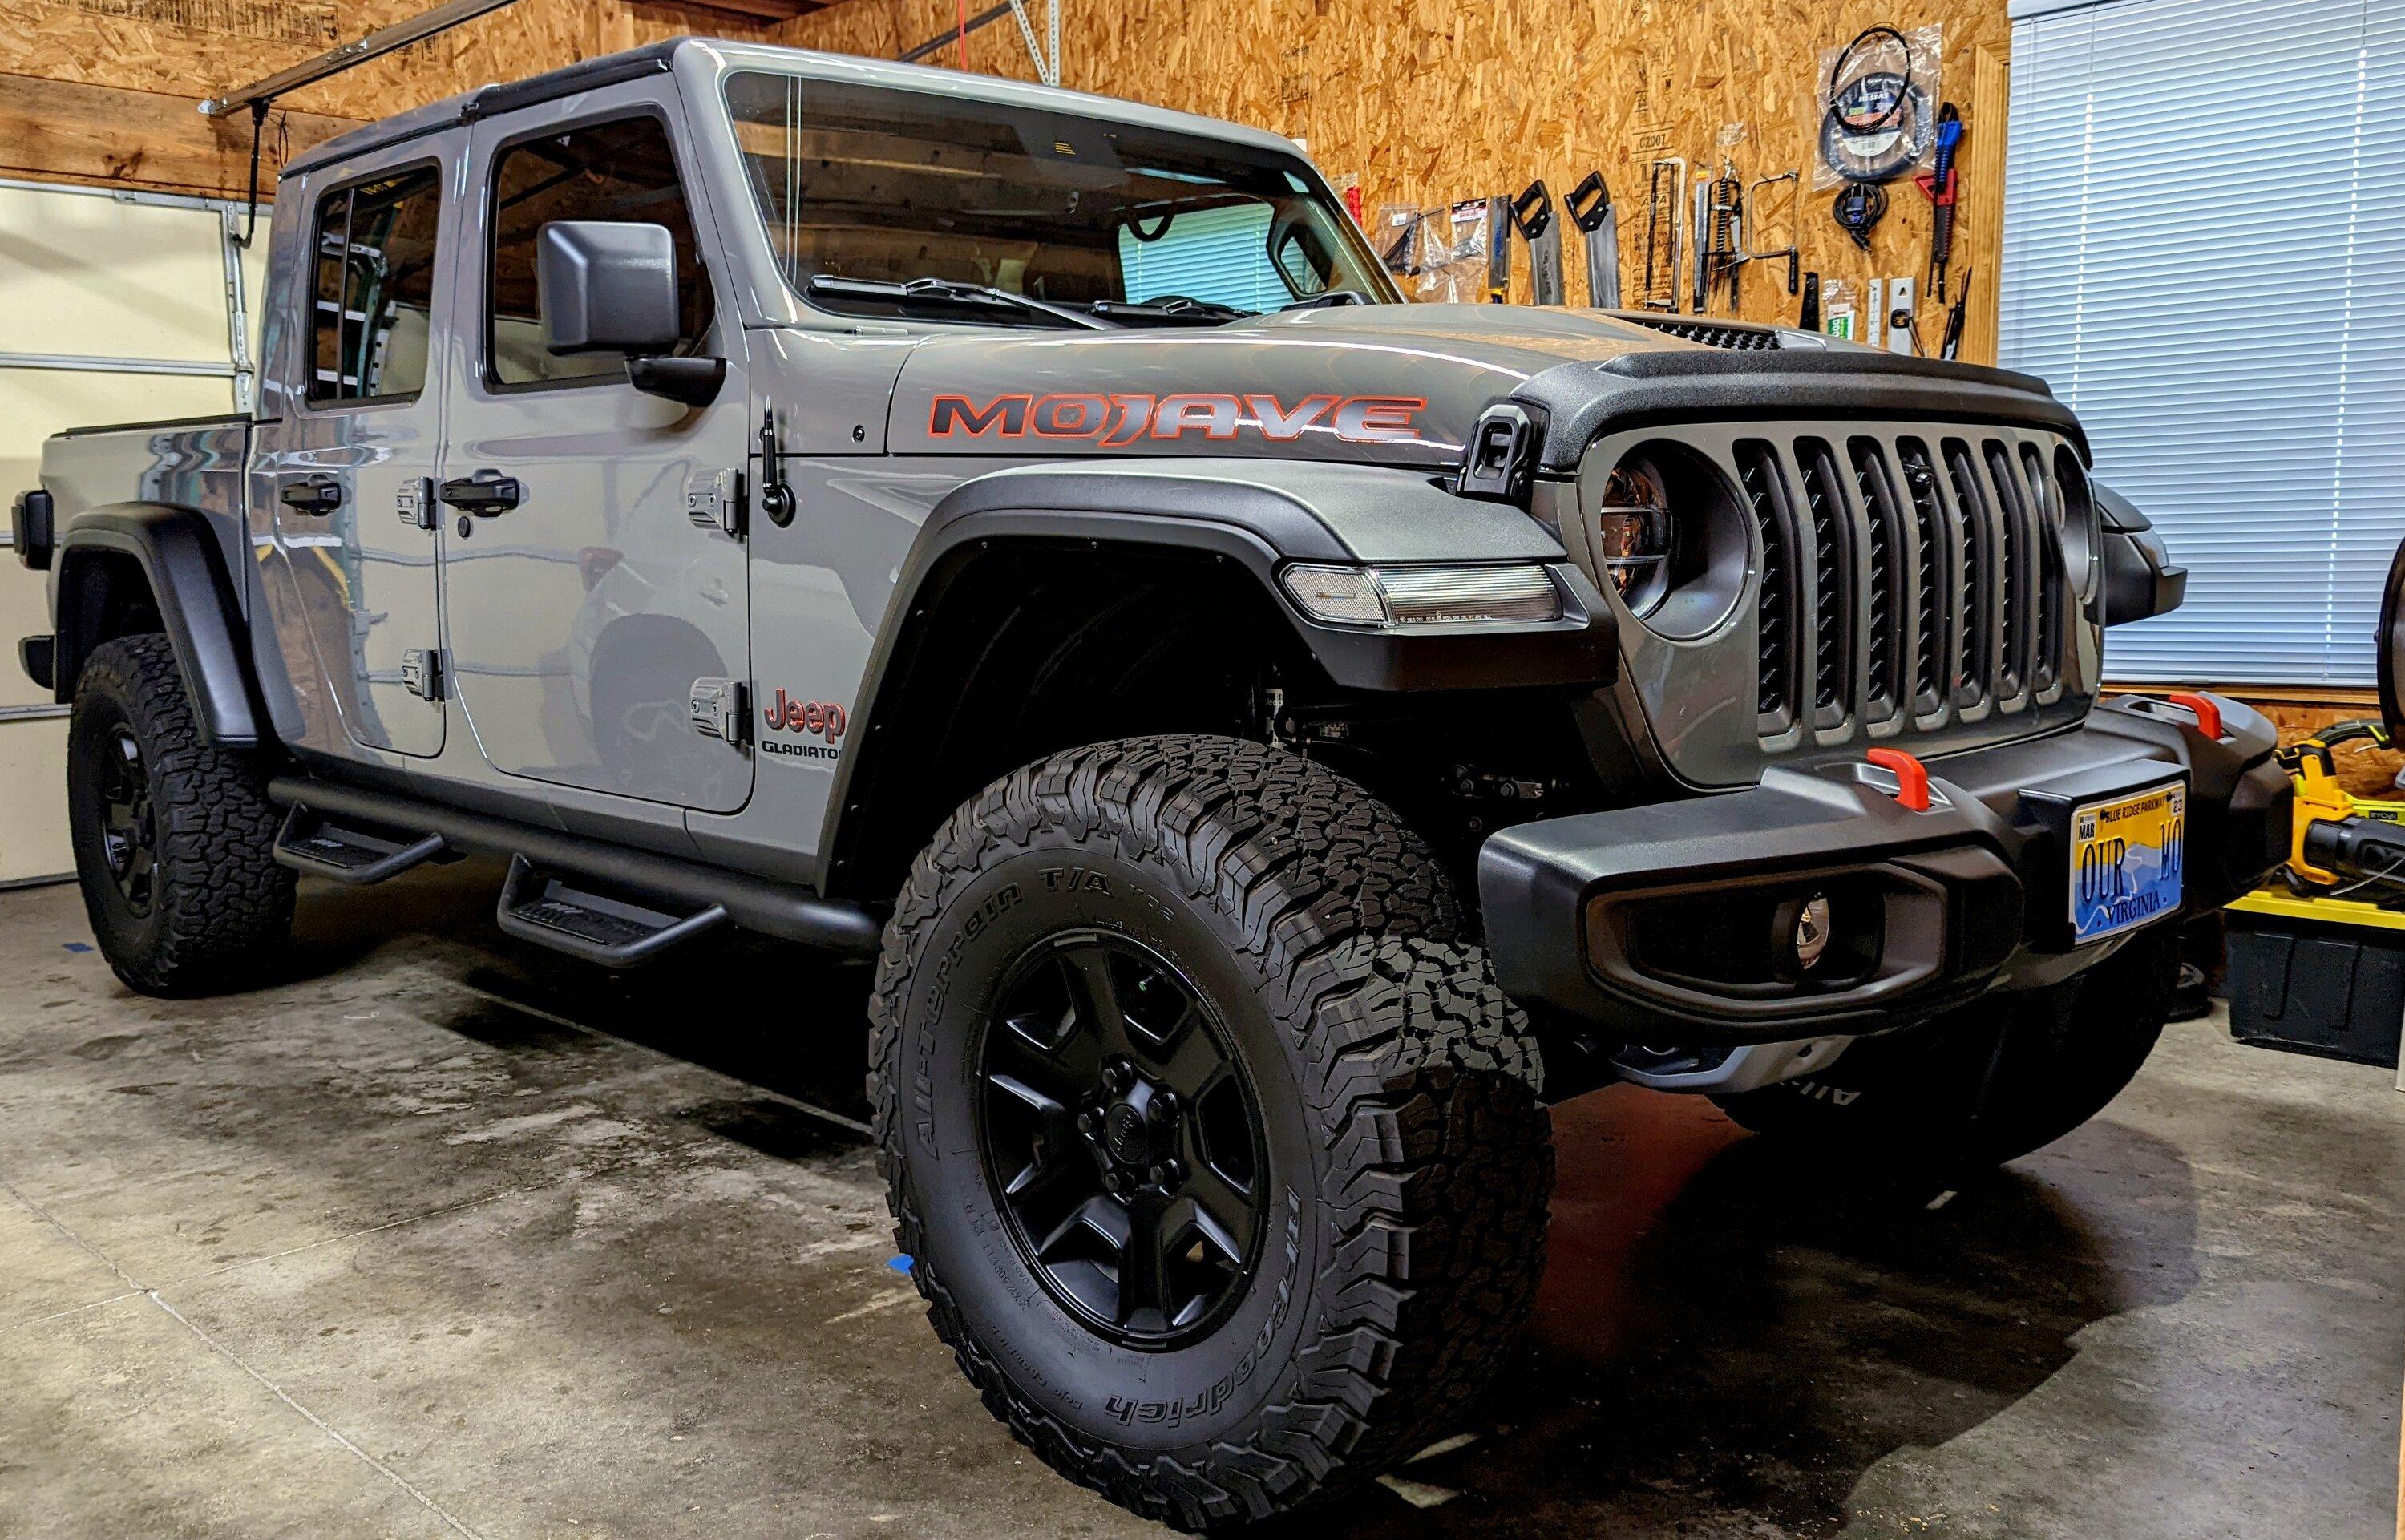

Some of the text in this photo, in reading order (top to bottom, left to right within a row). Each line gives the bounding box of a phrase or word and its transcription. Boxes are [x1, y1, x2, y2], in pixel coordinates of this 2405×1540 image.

[926, 393, 1429, 447] MOJAVE
[764, 688, 846, 745] Jeep
[2079, 823, 2095, 840] MAR
[2122, 803, 2140, 820] RIDGE
[2141, 795, 2165, 814] PARKWAY
[2173, 800, 2183, 814] 23
[2082, 836, 2125, 903] OUR
[2107, 890, 2161, 925] VIRGINIA
[912, 880, 1025, 1161] All-Terrain
[1038, 867, 1113, 895] T/A
[1105, 1183, 1303, 1428] BFGoodrich
